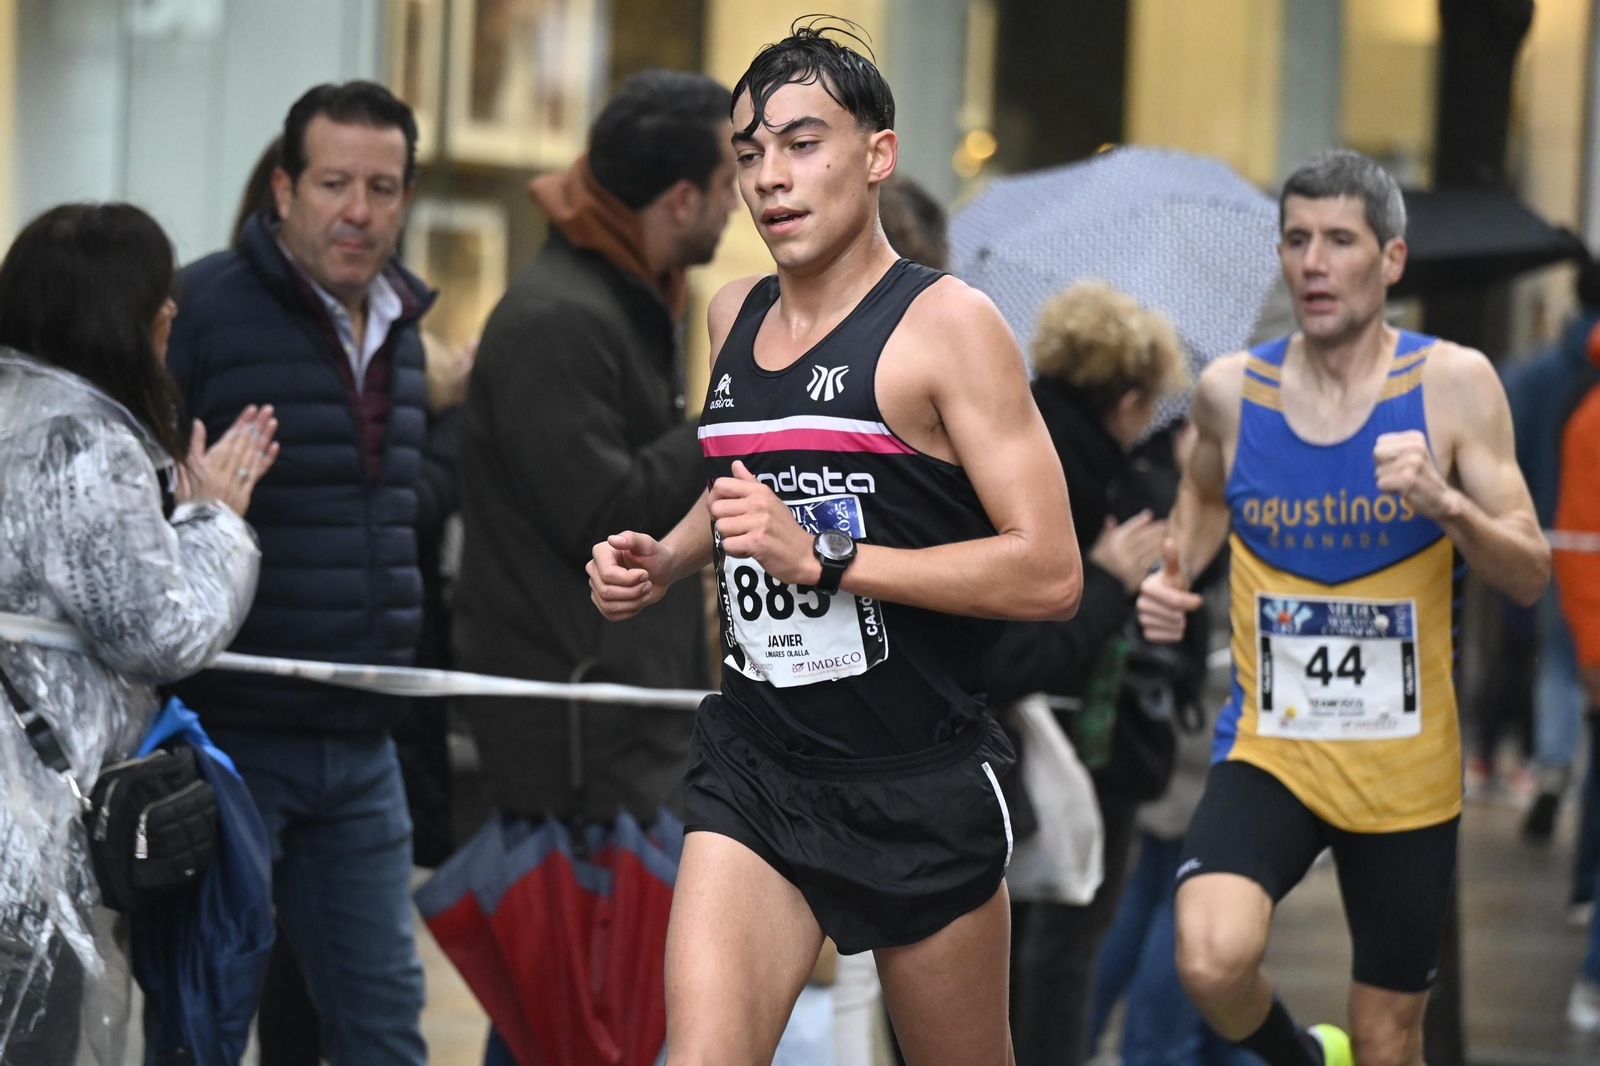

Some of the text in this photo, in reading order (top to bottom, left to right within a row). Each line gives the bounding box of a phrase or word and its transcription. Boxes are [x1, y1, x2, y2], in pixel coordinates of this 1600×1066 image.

[753, 465, 876, 496] ndata
[836, 500, 852, 537] 025
[1243, 488, 1415, 537] agustinos
[1269, 531, 1389, 549] GRANADA
[733, 565, 831, 621] 885
[859, 596, 878, 636] CAJÓ
[765, 649, 810, 658] LINARES OLALLA
[768, 634, 803, 648] JAVIER
[807, 652, 862, 671] IMDECO
[1305, 645, 1366, 687] 44
